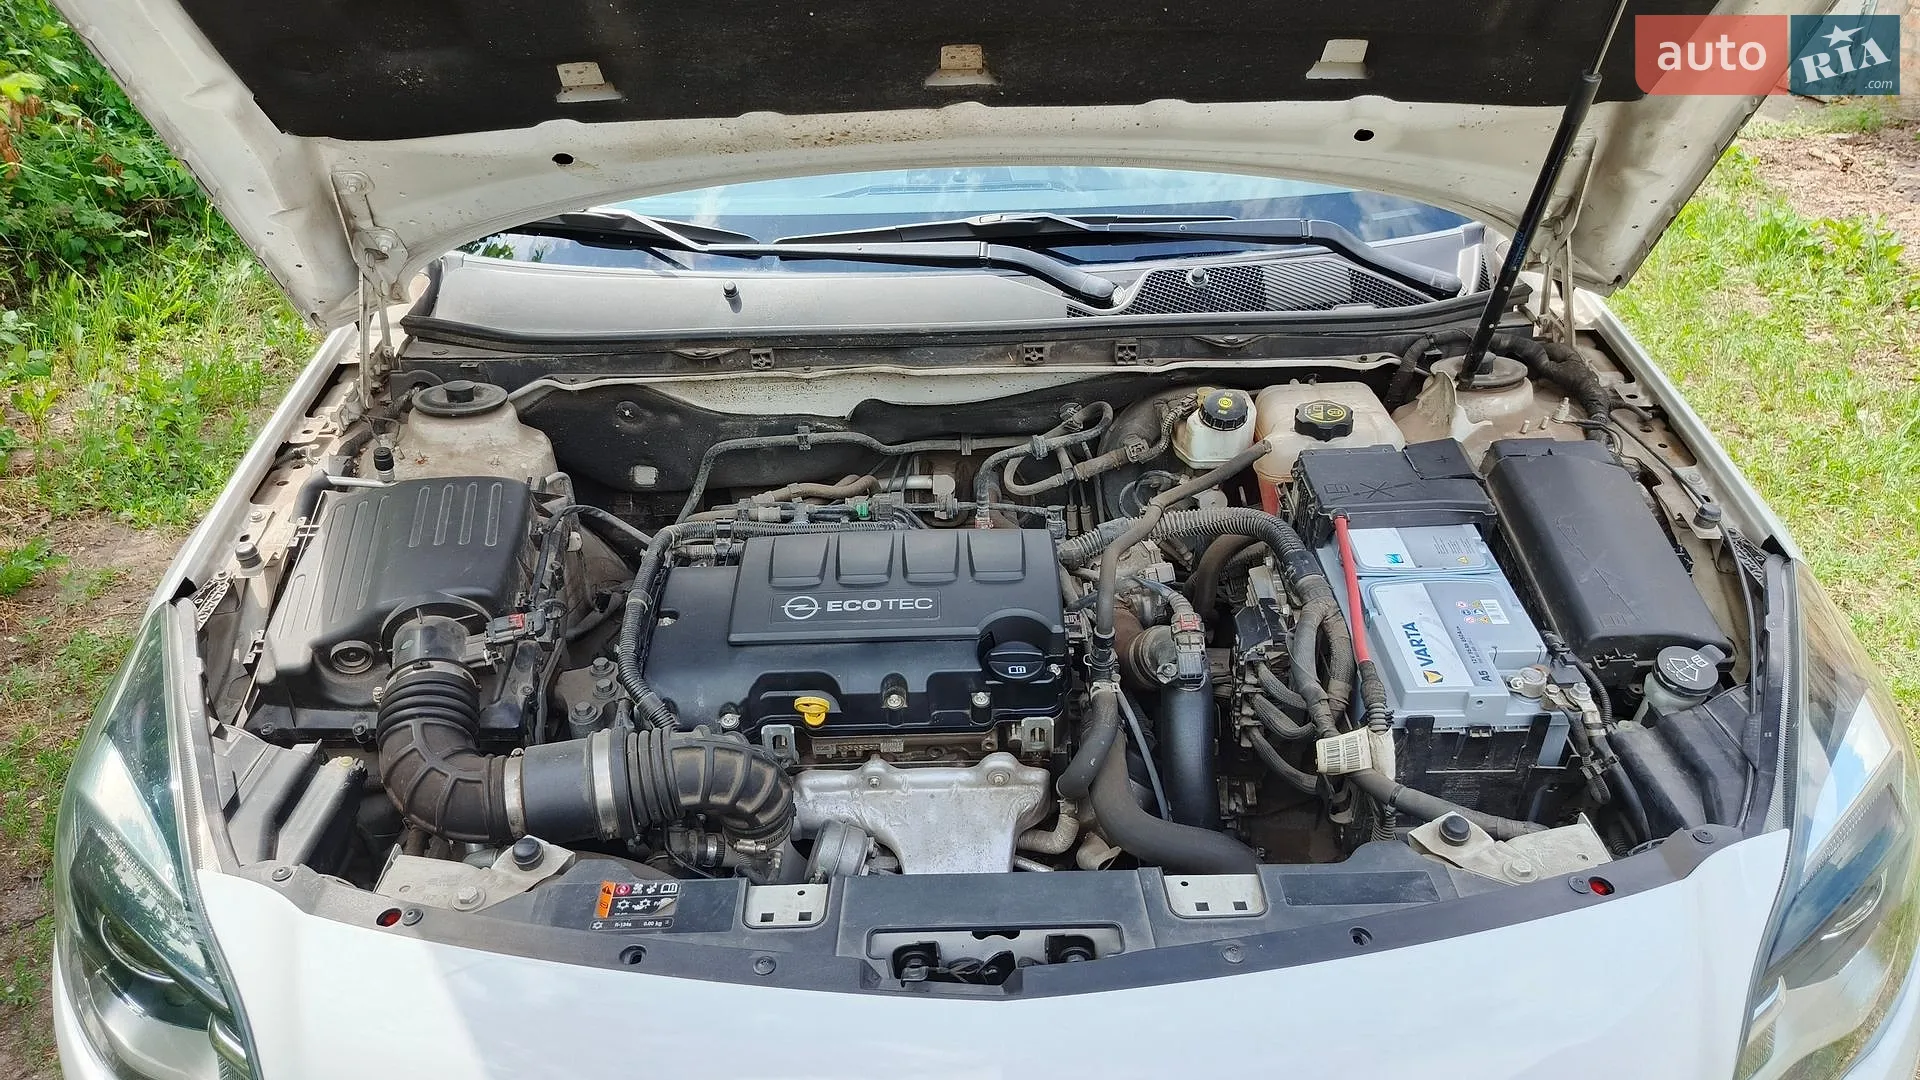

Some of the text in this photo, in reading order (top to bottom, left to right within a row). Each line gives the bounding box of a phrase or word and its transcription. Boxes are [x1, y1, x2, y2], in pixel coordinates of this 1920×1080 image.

[826, 597, 933, 612] ECOTEC
[1401, 622, 1435, 667] VARTA
[1478, 670, 1492, 682] A5
